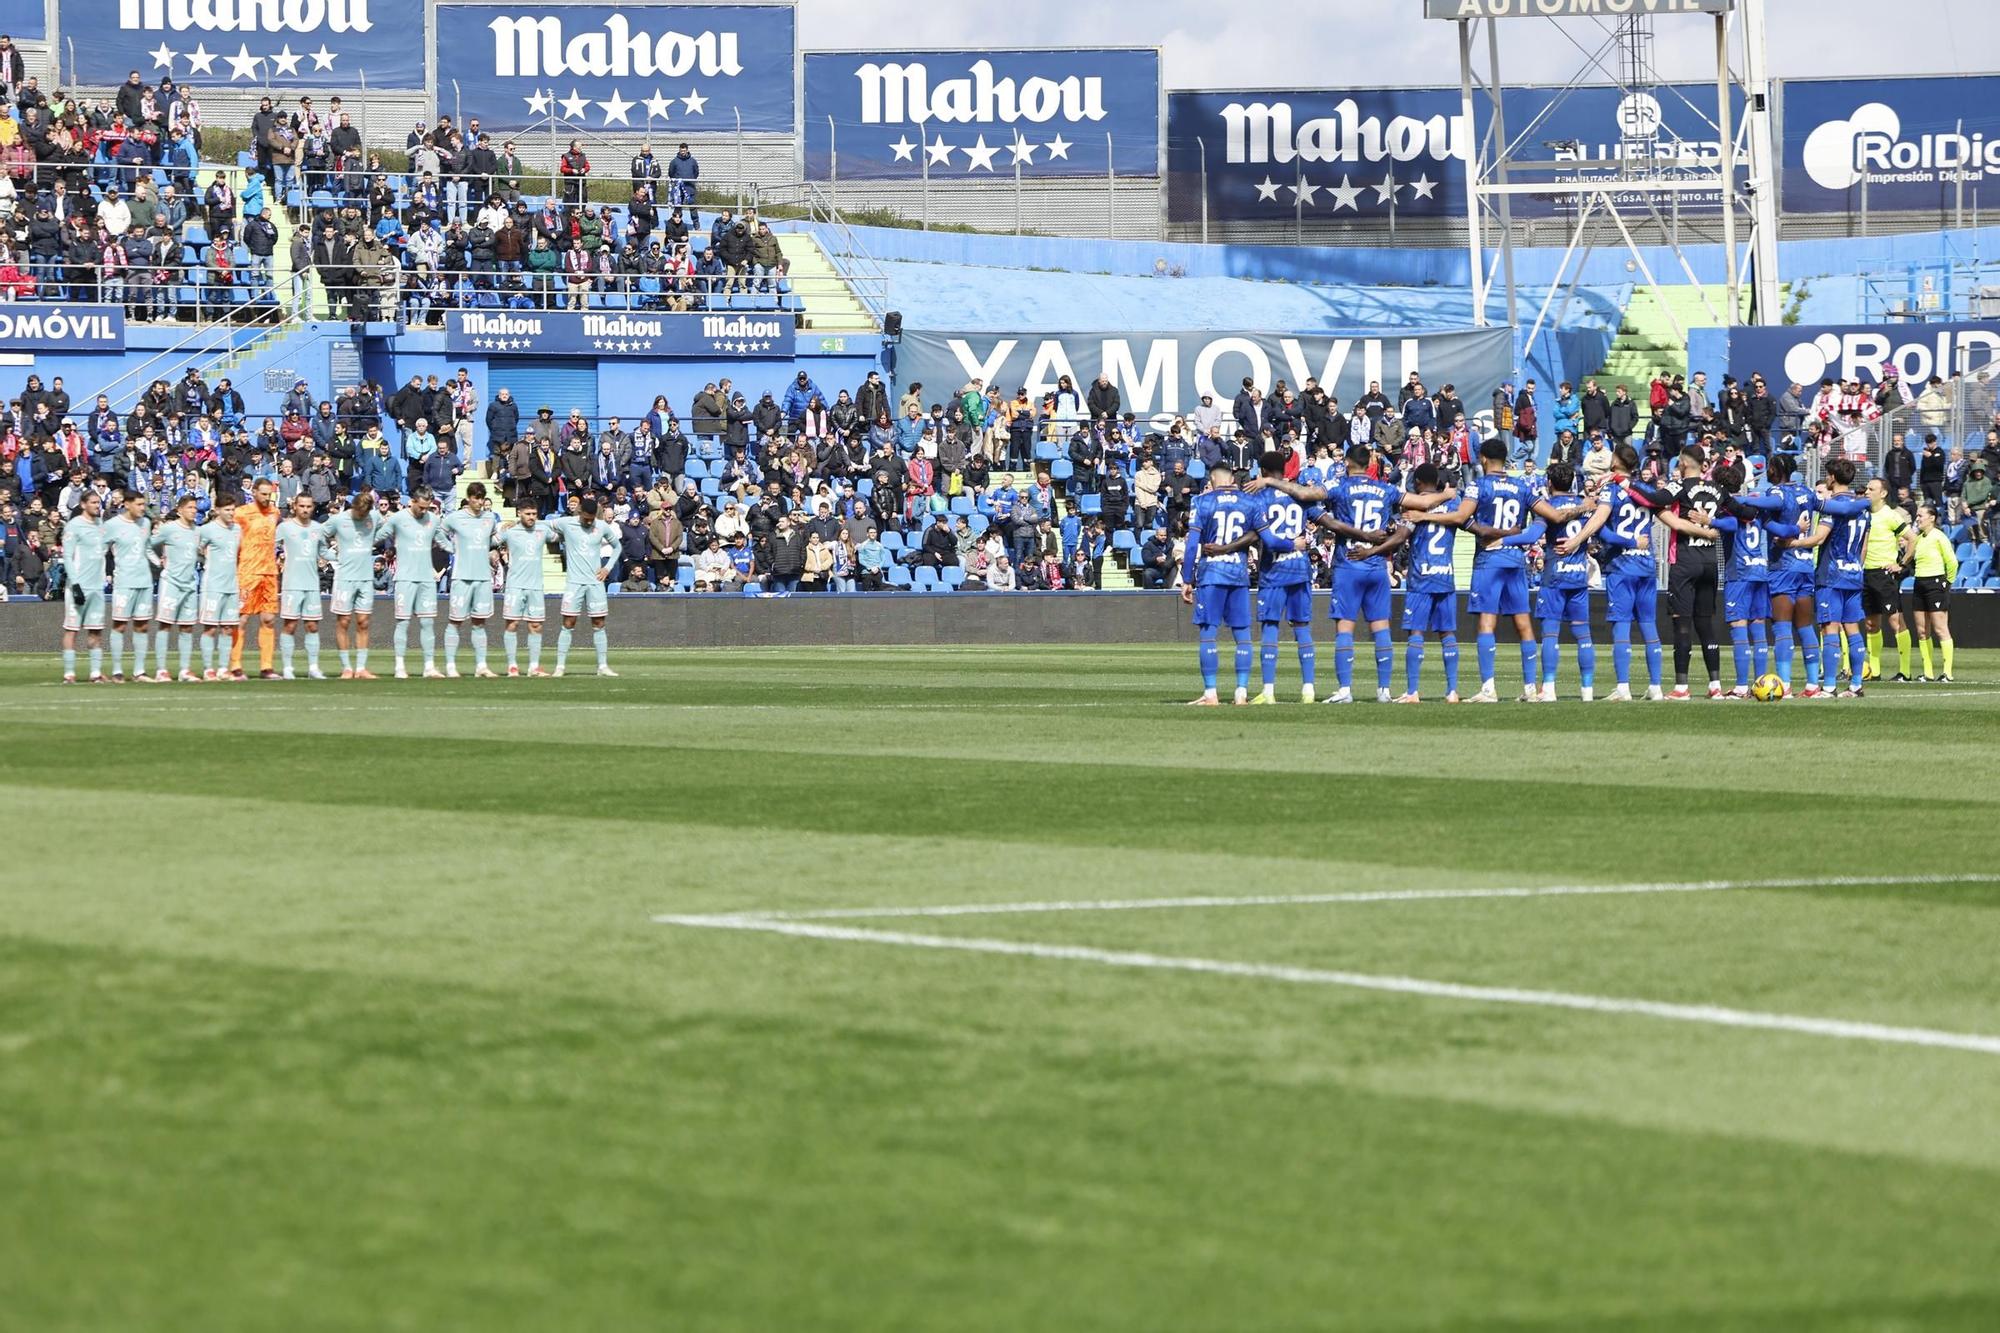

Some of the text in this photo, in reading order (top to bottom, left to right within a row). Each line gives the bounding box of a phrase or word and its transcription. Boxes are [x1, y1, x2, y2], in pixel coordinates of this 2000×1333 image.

[488, 13, 744, 77] Mahou
[854, 60, 1108, 123] Mahou
[1219, 98, 1467, 163] Mahou
[1866, 171, 1933, 184] Impresión
[461, 313, 543, 336] Mahou
[583, 314, 663, 337] Mahou
[702, 315, 782, 338] Mahou
[1213, 511, 1246, 545] 16
[1268, 503, 1303, 540] 29
[1351, 500, 1385, 532] 15
[1492, 497, 1521, 530] 18
[1617, 503, 1650, 539] 22
[1427, 521, 1446, 555] 2
[1746, 523, 1760, 549] 5
[1848, 519, 1867, 554] 11
